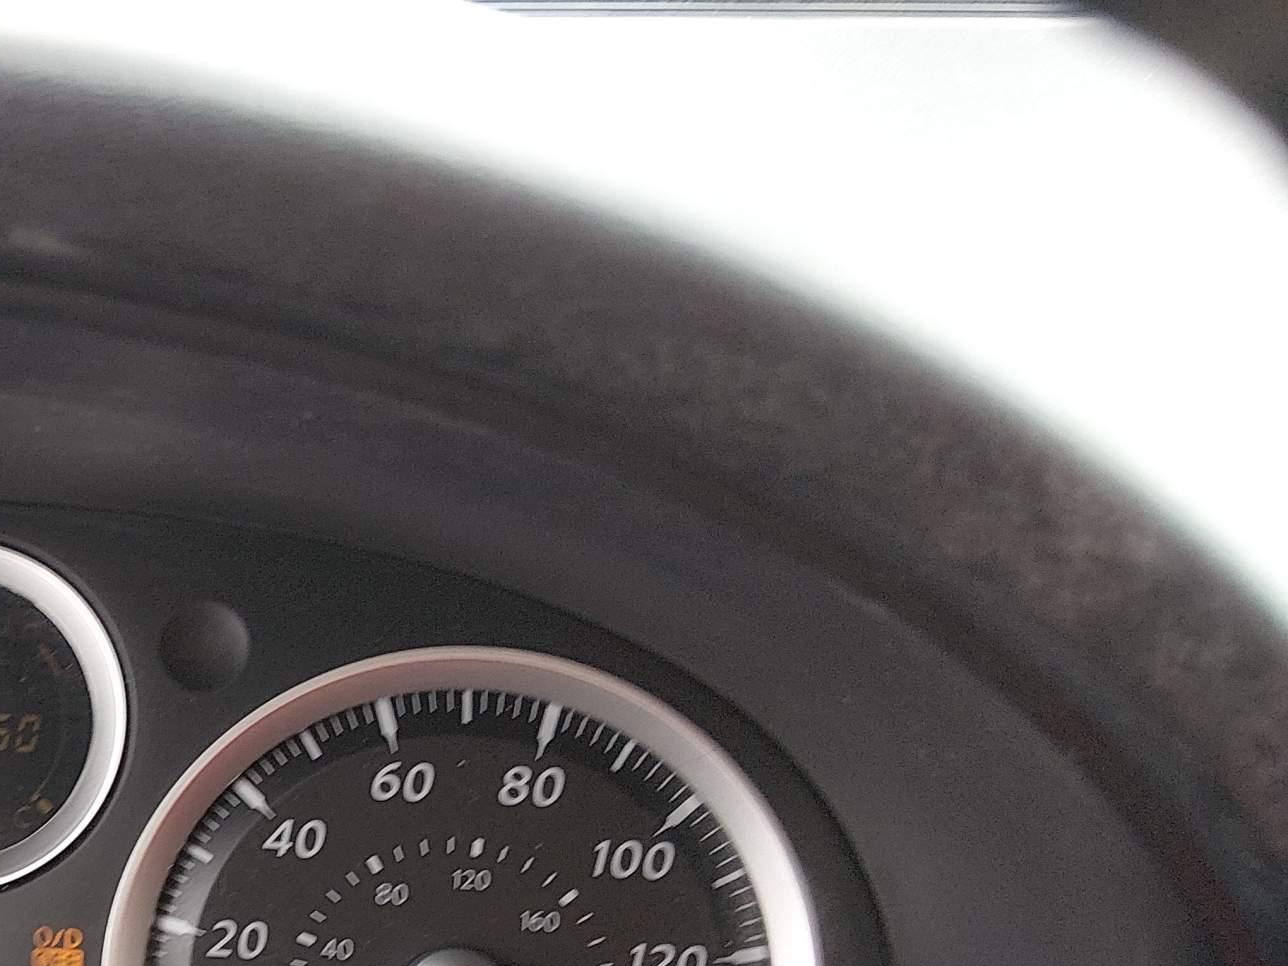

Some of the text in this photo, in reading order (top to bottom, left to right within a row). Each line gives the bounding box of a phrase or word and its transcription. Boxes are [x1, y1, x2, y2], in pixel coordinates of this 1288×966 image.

[370, 762, 435, 801] 60
[497, 766, 565, 807] 80
[262, 819, 326, 858] 40
[452, 868, 491, 891] 120
[592, 841, 674, 881] 100
[374, 882, 409, 905] 80
[206, 920, 268, 959] 20
[520, 911, 560, 933] 160
[321, 938, 354, 960] 40
